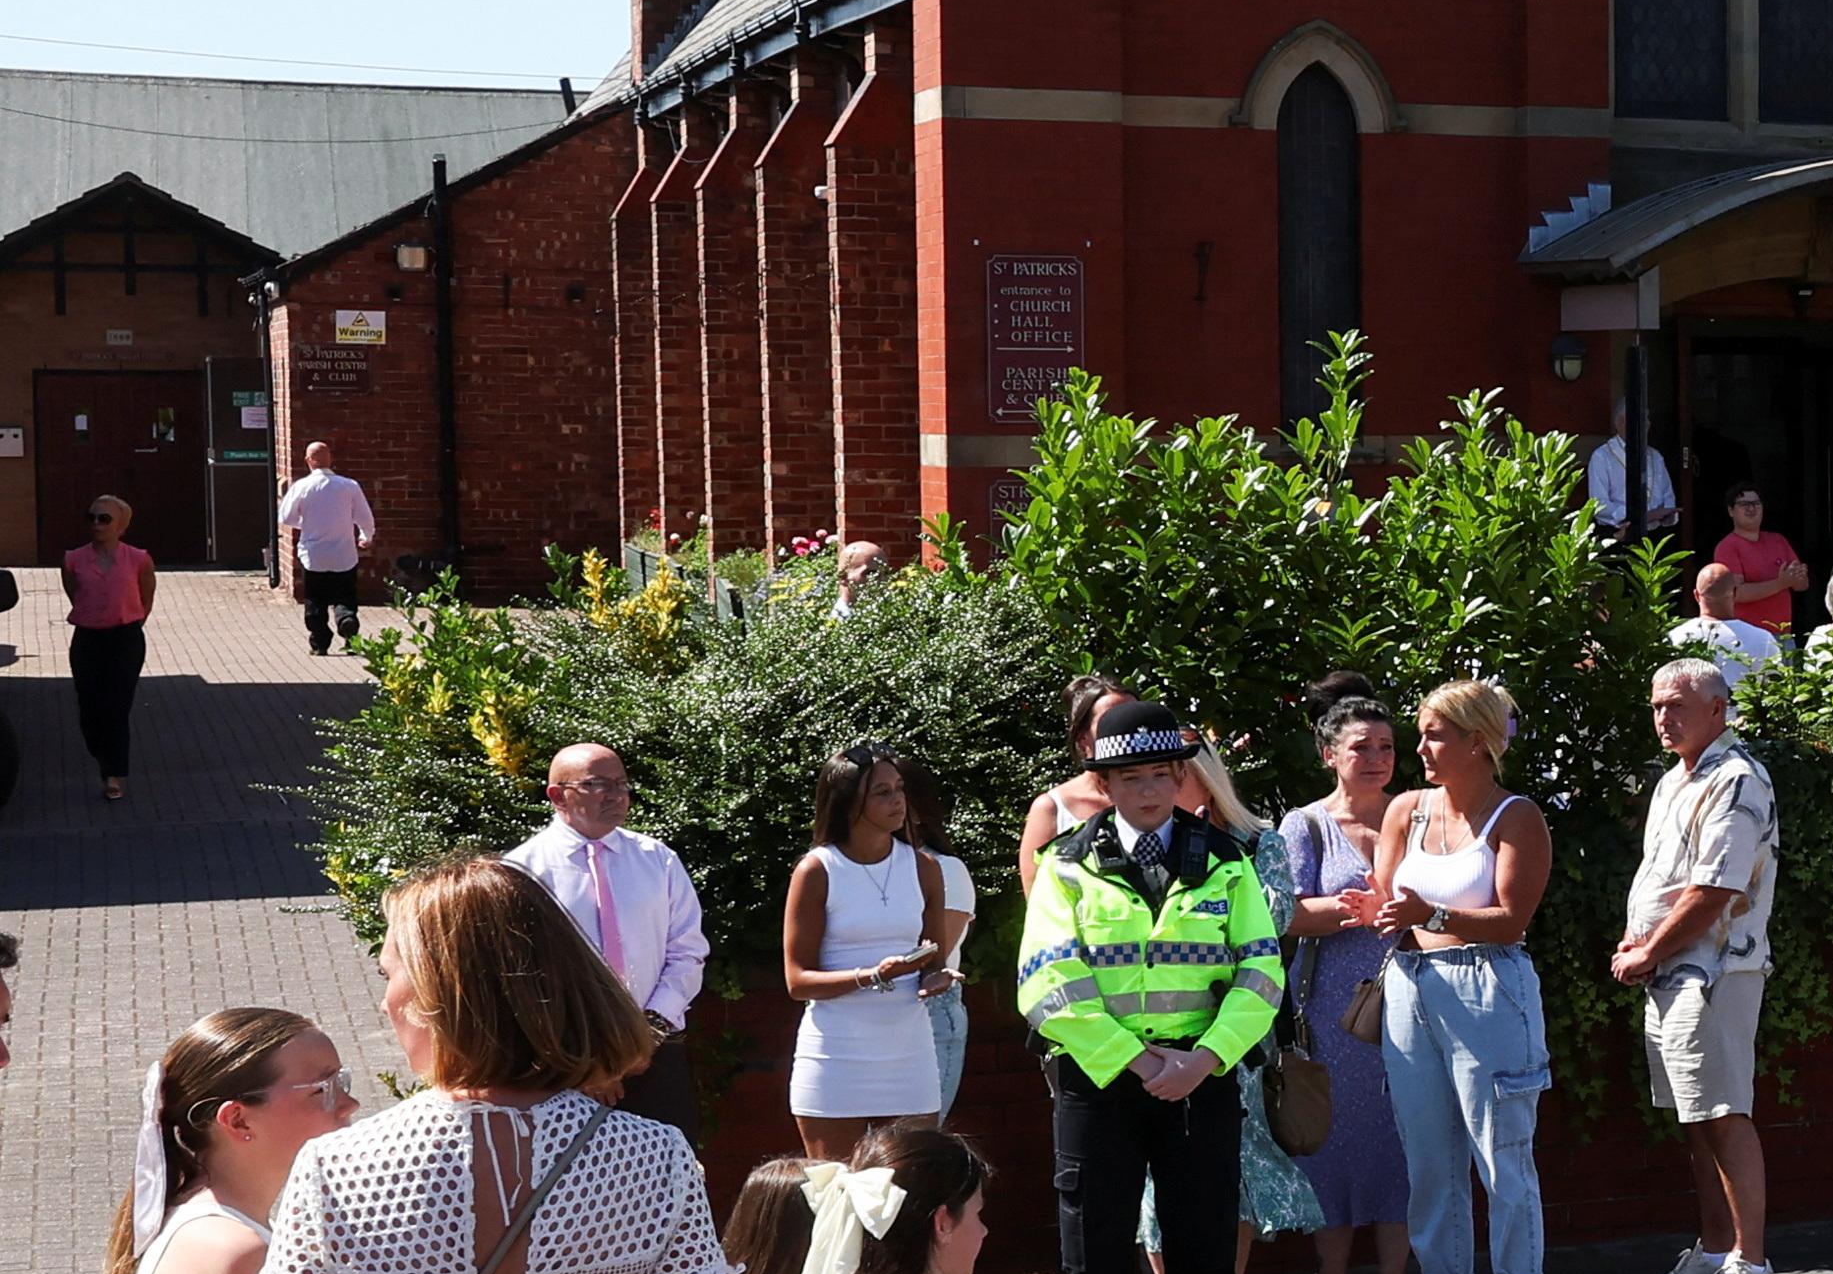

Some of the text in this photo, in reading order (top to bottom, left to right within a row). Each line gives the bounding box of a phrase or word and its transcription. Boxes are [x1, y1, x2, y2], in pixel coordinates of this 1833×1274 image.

[1013, 262, 1077, 276] PATRICKS
[1000, 286, 1072, 296] entrance to
[1010, 300, 1071, 313] CHURCH
[1011, 315, 1054, 328] HALL
[338, 327, 383, 339] Warning
[1011, 331, 1073, 343] OFFICE
[312, 372, 357, 381] & CLUB
[1006, 367, 1067, 379] PARISH
[1006, 393, 1019, 405] &
[1196, 902, 1226, 913] OLICE
